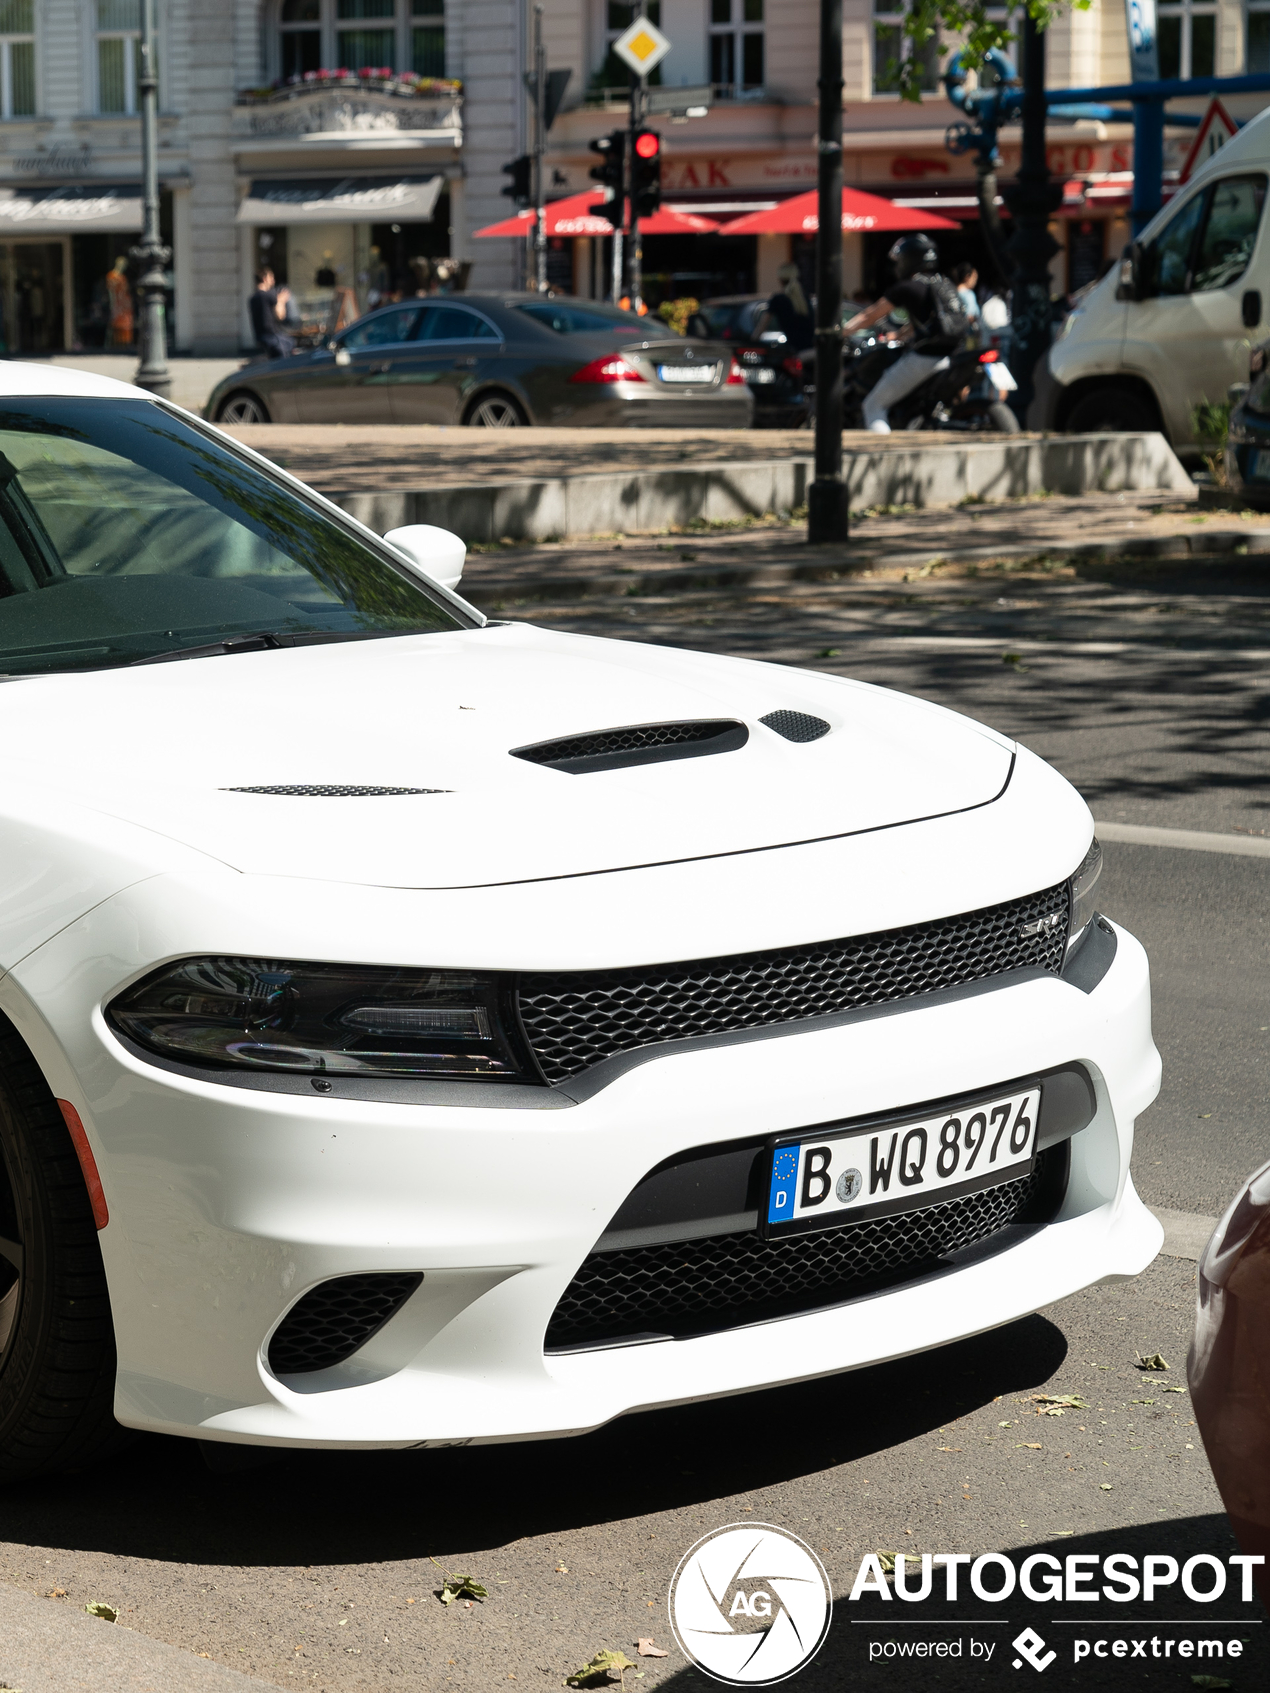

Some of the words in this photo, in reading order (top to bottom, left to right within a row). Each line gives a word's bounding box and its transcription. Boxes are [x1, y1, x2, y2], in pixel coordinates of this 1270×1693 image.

[800, 1147, 832, 1208] B
[869, 1127, 928, 1195] WQ
[937, 1097, 1031, 1178] 8976
[775, 1191, 787, 1209] D
